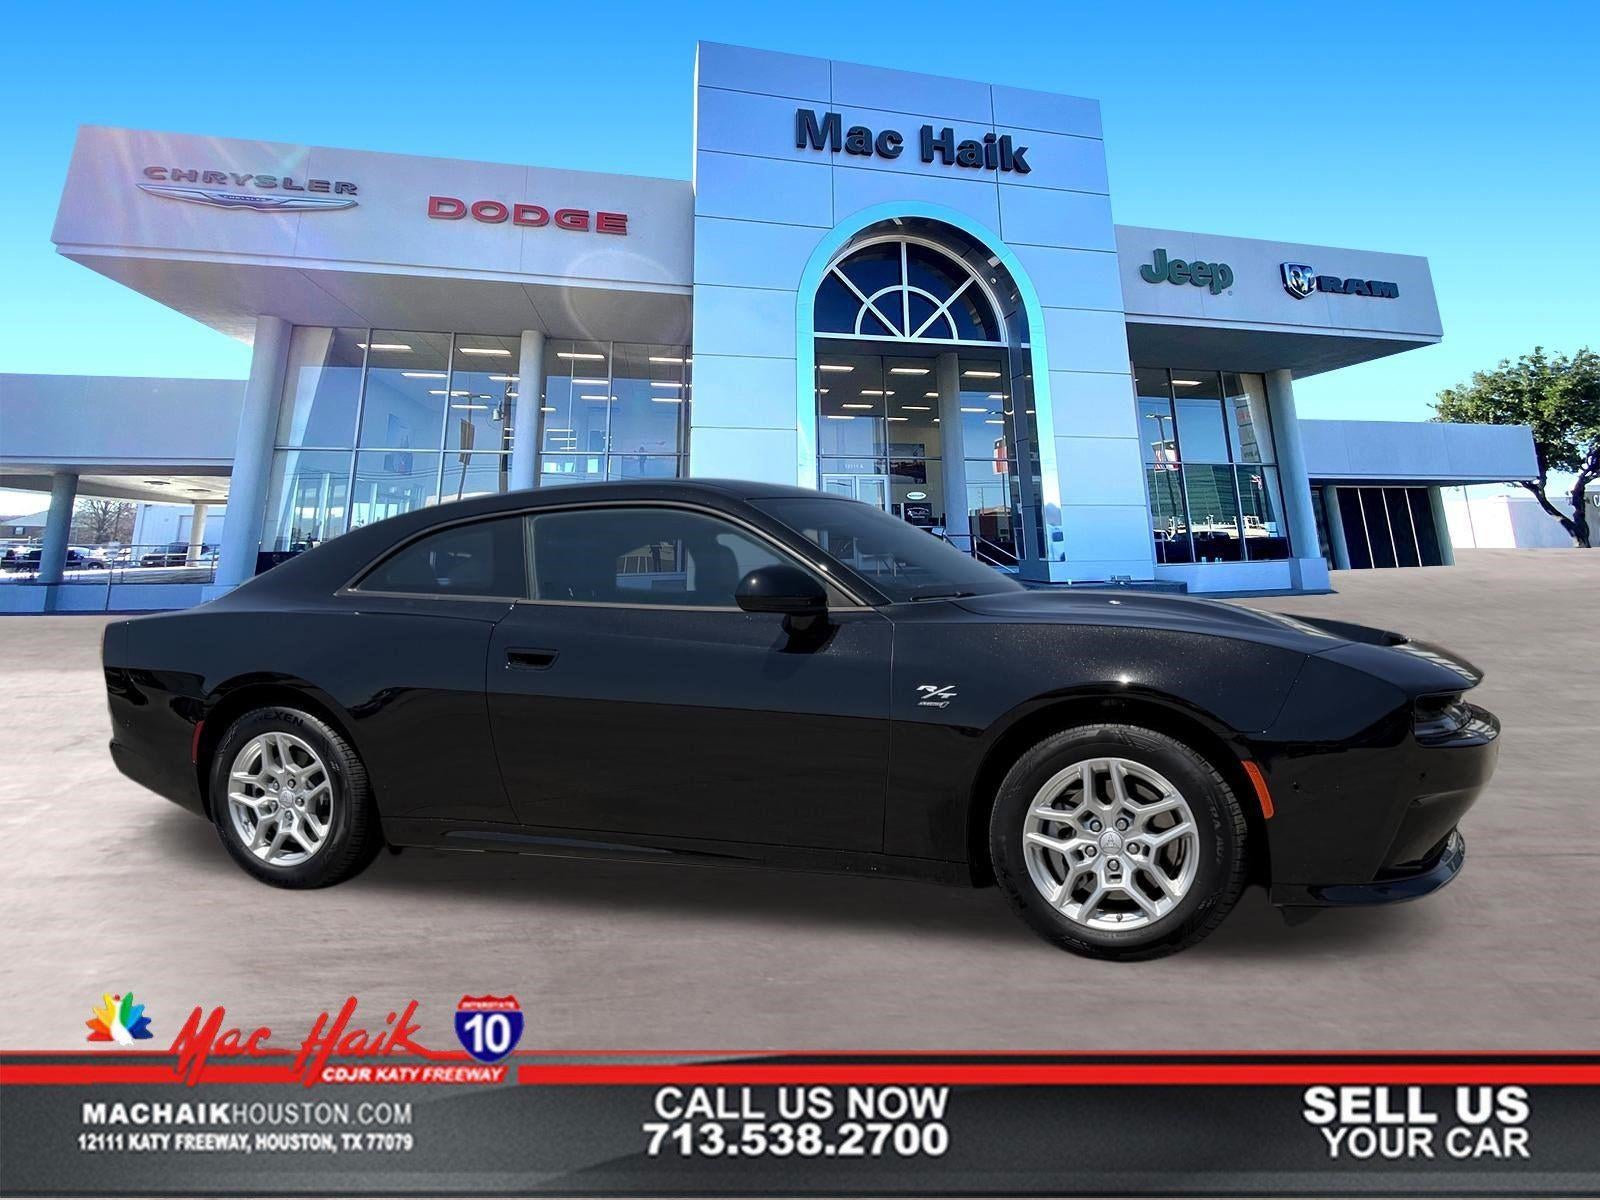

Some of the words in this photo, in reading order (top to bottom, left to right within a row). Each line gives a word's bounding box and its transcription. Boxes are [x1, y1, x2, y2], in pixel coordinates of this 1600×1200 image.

[796, 108, 904, 160] Mac
[919, 125, 1032, 174] Haik
[143, 166, 358, 196] CHRYSLER
[428, 196, 628, 236] DODGE
[1139, 248, 1234, 295] Jeep
[1315, 275, 1400, 299] RAM
